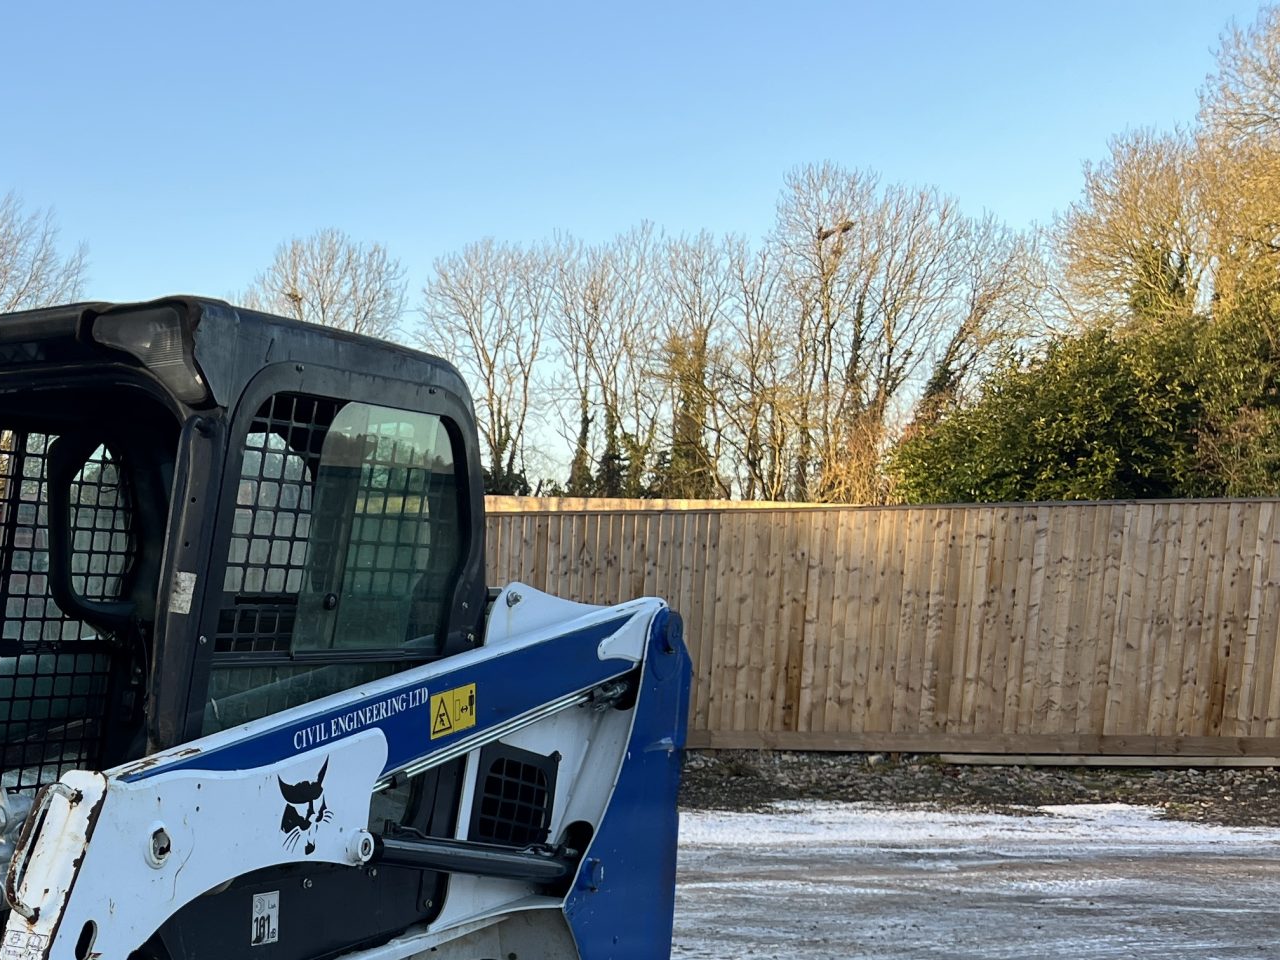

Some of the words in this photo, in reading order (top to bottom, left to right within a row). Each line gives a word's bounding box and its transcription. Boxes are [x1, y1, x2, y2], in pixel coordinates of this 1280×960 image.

[293, 723, 328, 749] CIVIL
[331, 694, 406, 738] ENGINEERING
[409, 687, 428, 709] LTD
